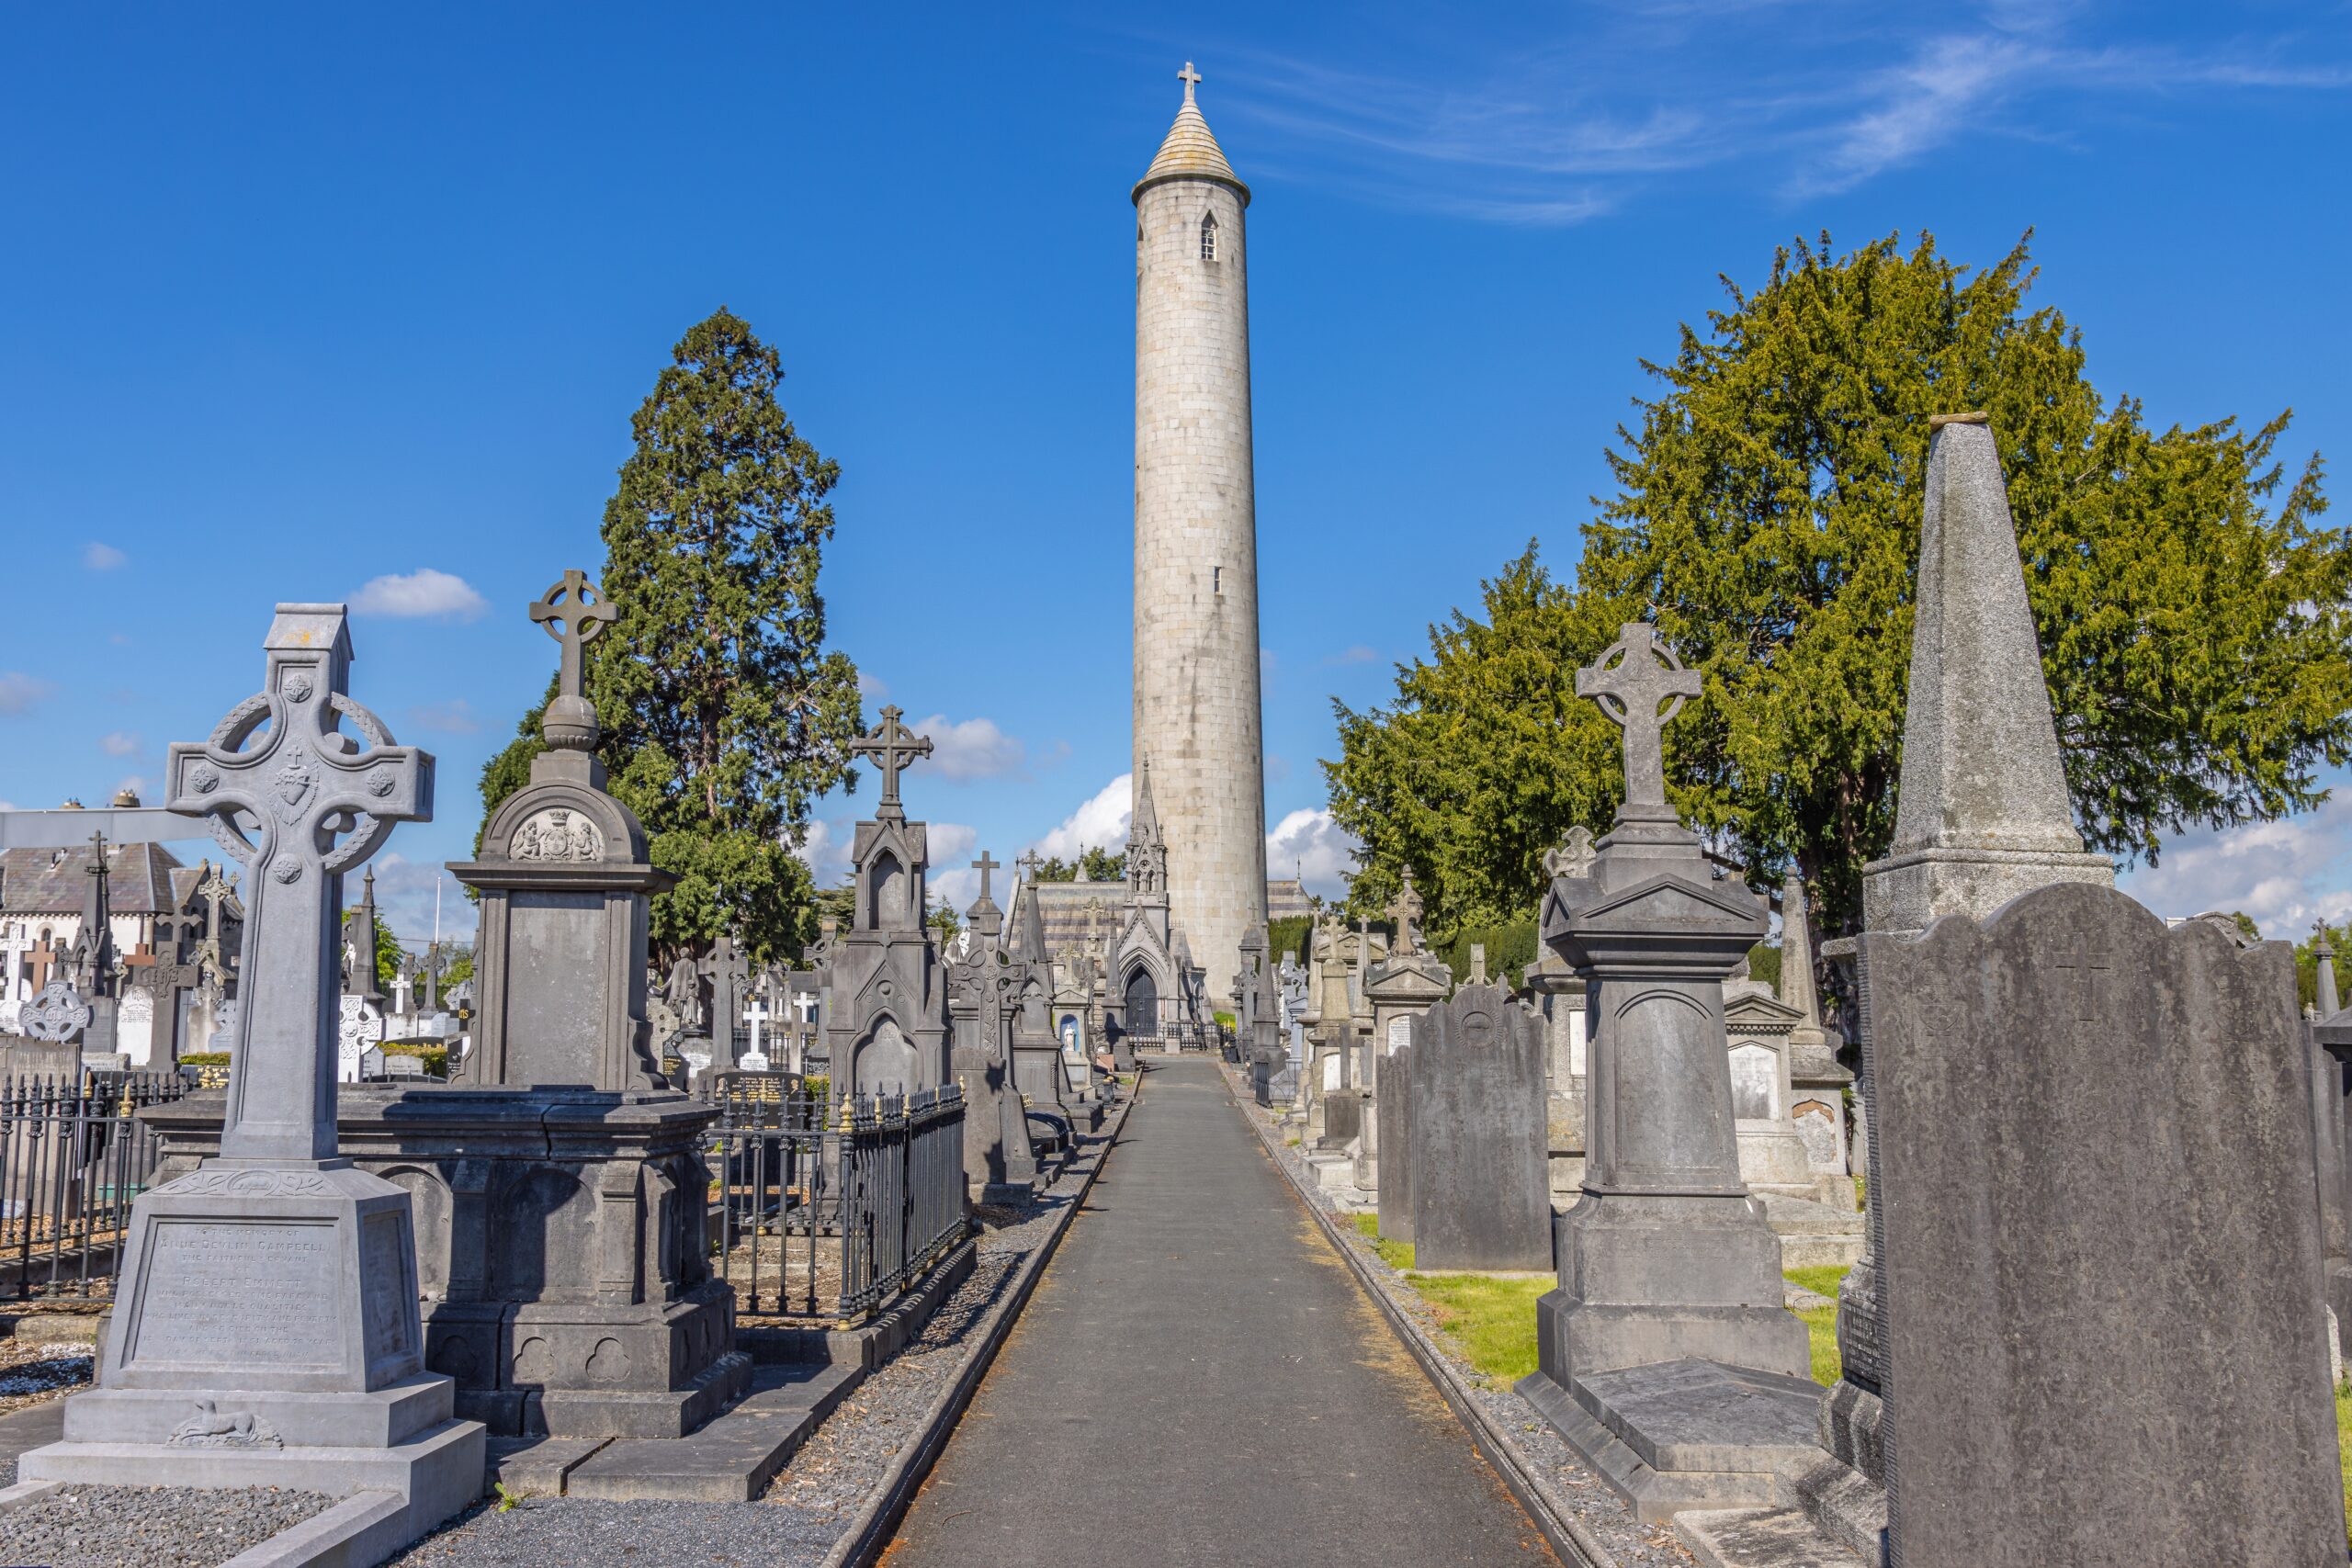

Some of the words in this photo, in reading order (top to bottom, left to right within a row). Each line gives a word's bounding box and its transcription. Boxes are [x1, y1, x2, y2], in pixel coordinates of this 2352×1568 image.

[161, 1238, 196, 1250] ANNE
[201, 1239, 250, 1250] DEVLIN
[182, 1254, 202, 1262] THE
[207, 1255, 256, 1263] FAITHFUL
[183, 1276, 236, 1288] ROBERT
[250, 1303, 310, 1311] QUALITIES
